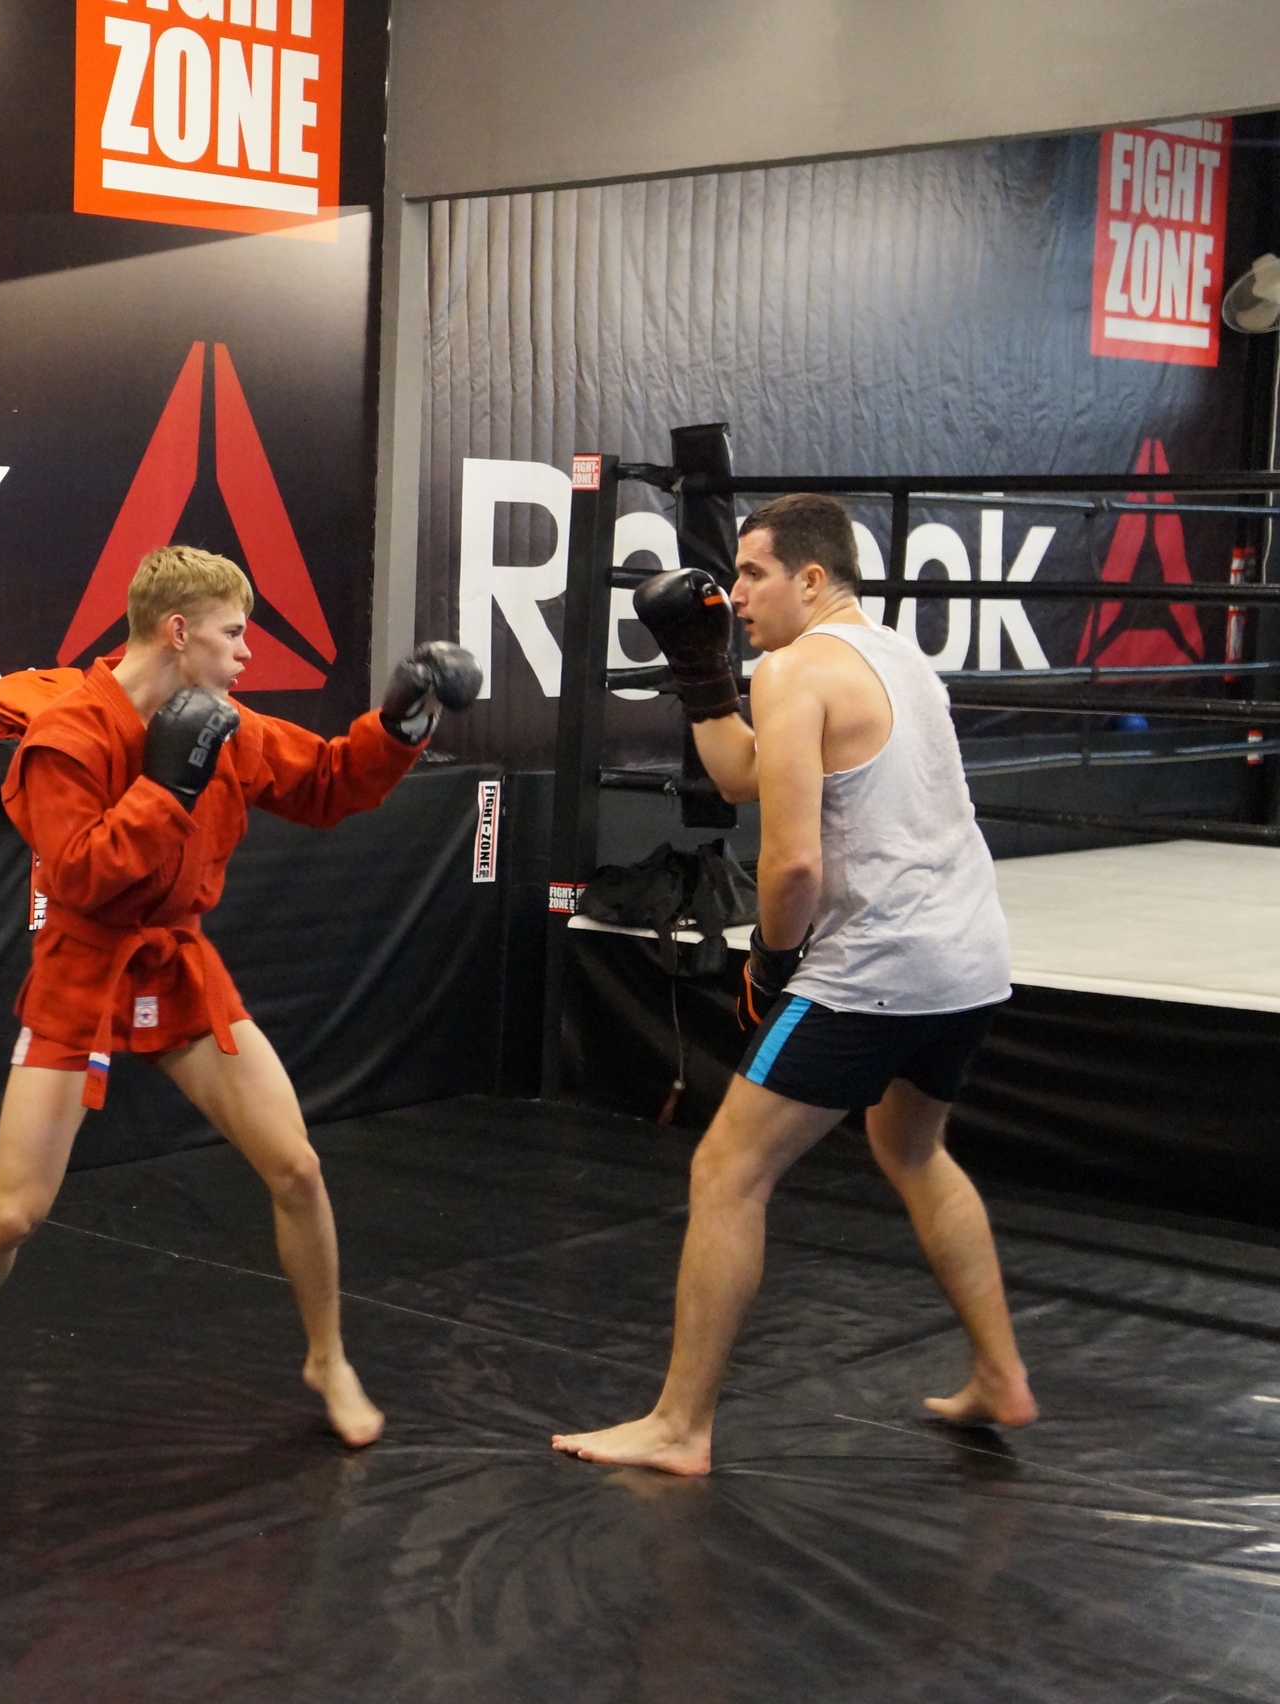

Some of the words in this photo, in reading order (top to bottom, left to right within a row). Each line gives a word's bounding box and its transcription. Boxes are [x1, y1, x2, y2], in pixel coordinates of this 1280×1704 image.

[101, 15, 319, 179] ZONE
[1110, 131, 1221, 225] FIGHT
[1104, 220, 1214, 323] ZONE
[460, 458, 1056, 700] Reok
[479, 785, 496, 869] FIGHT-ZONE
